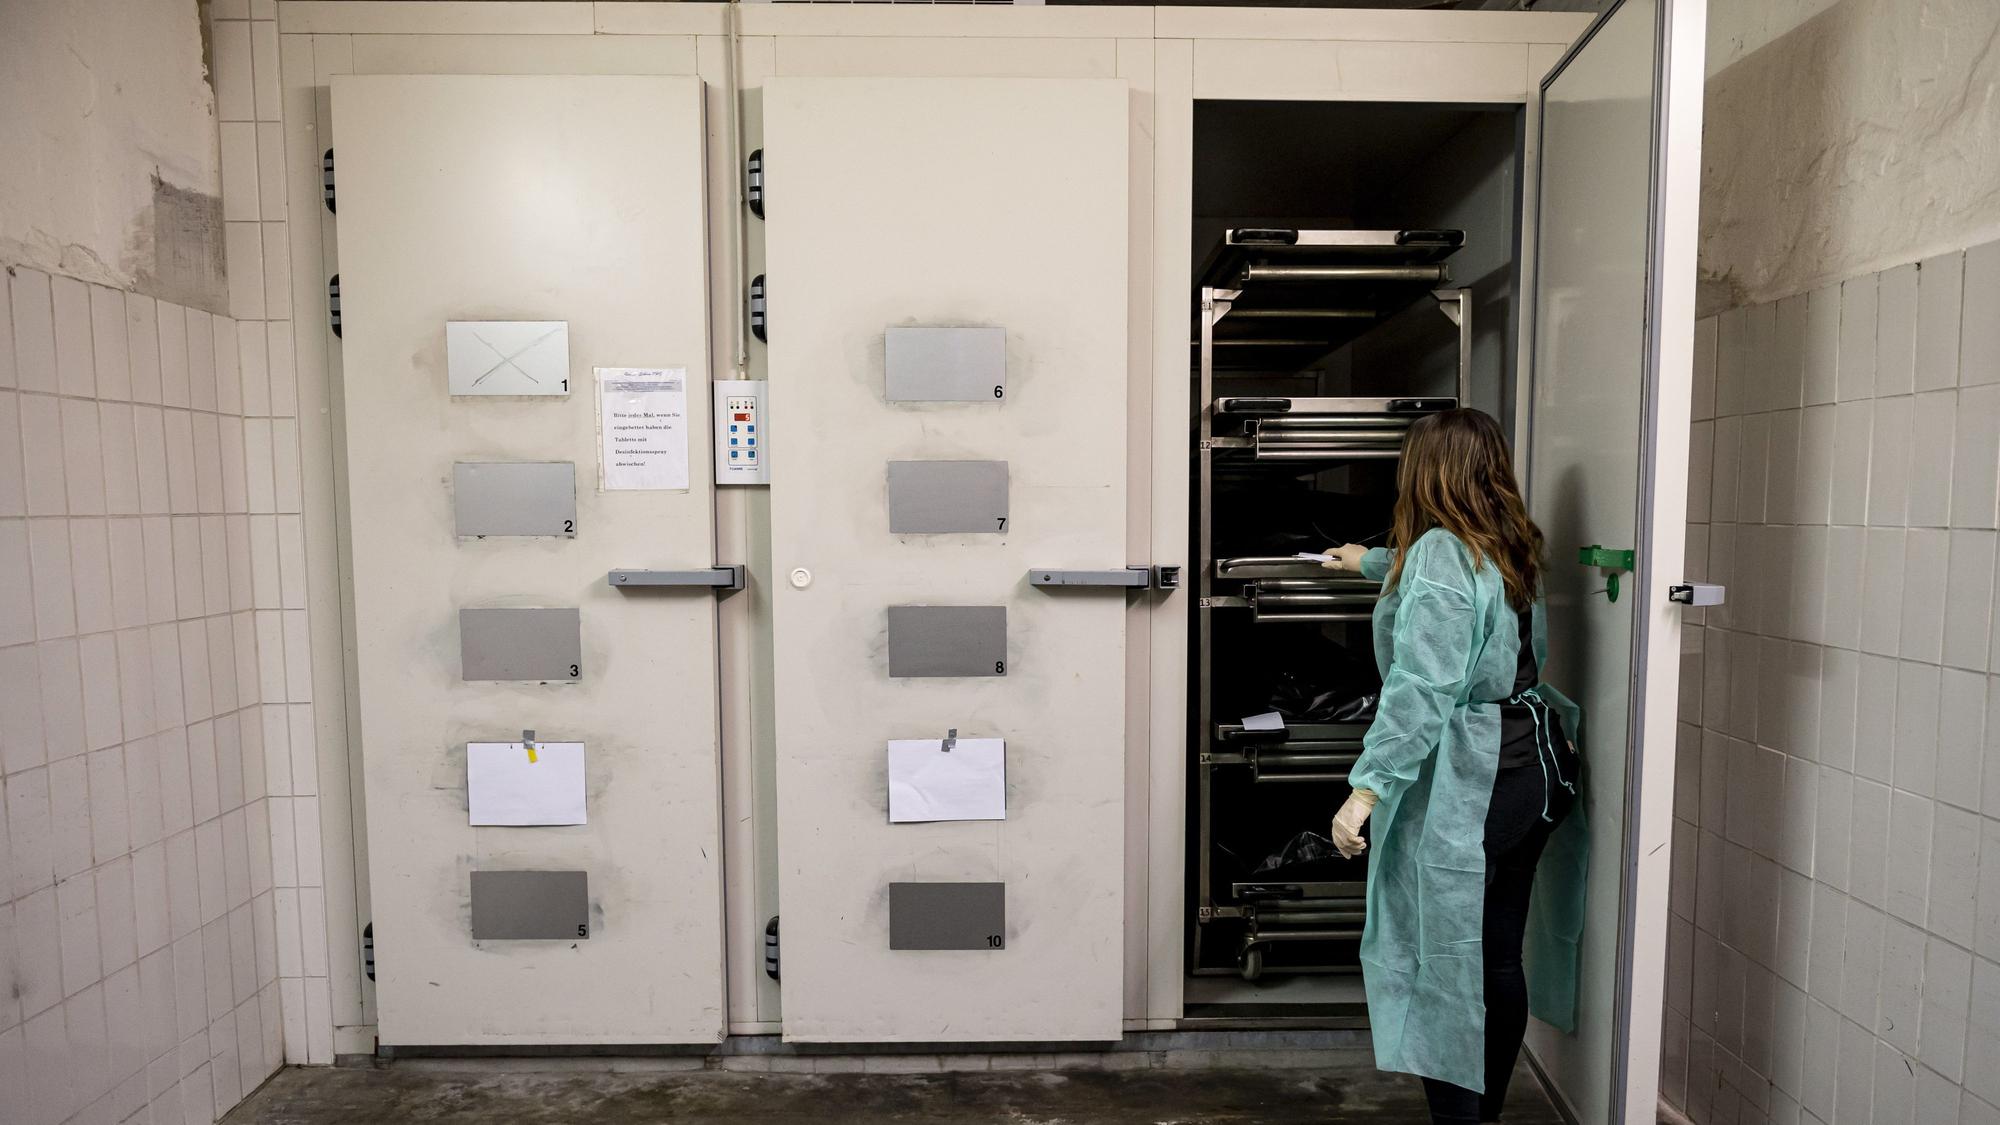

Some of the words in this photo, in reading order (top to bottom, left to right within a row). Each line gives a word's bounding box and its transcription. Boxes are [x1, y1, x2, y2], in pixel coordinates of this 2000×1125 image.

[561, 379, 568, 392] 1
[994, 385, 1003, 399] 6
[1200, 441, 1211, 449] 12
[564, 519, 574, 532] 2
[997, 517, 1006, 531] 7
[1200, 599, 1211, 607] 13
[569, 664, 579, 677] 3
[995, 660, 1005, 674] 8
[1201, 754, 1212, 762] 14
[1200, 908, 1210, 916] 15
[577, 924, 587, 937] 5
[986, 935, 1003, 948] 10
